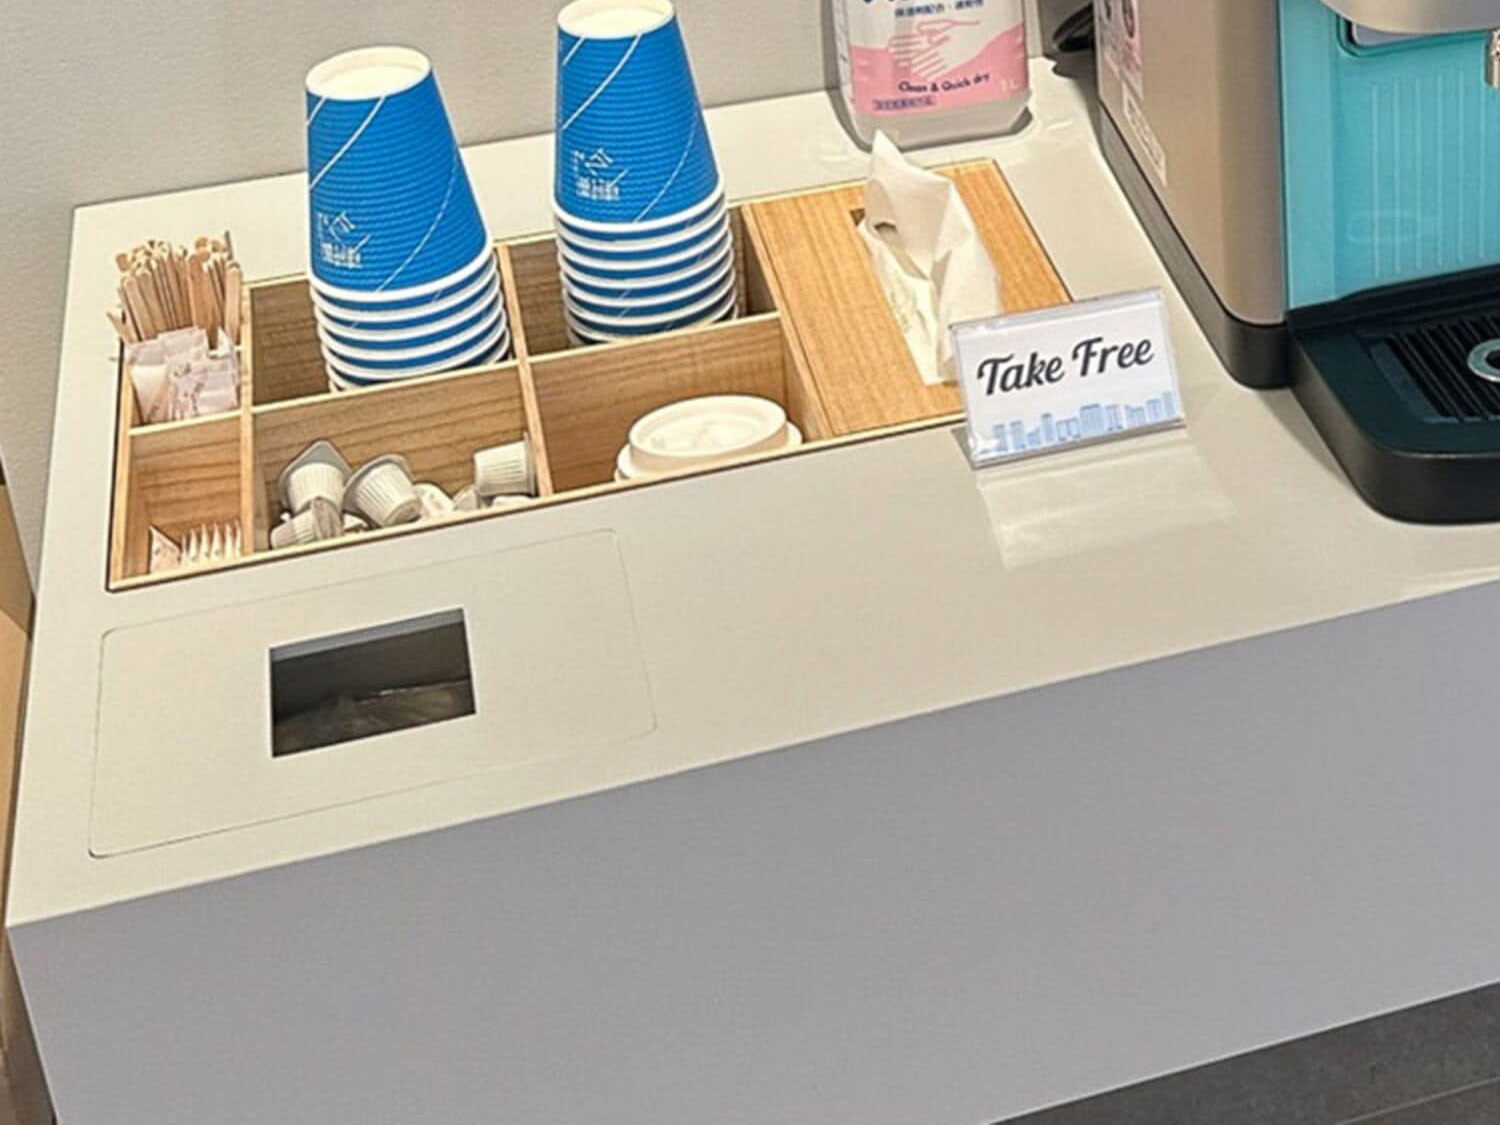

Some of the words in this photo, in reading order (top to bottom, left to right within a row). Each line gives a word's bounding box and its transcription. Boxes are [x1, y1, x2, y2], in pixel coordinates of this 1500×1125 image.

[898, 80, 927, 92] Clean
[941, 79, 971, 91] Quick
[977, 353, 1065, 396] Take
[1071, 336, 1155, 377] Free
